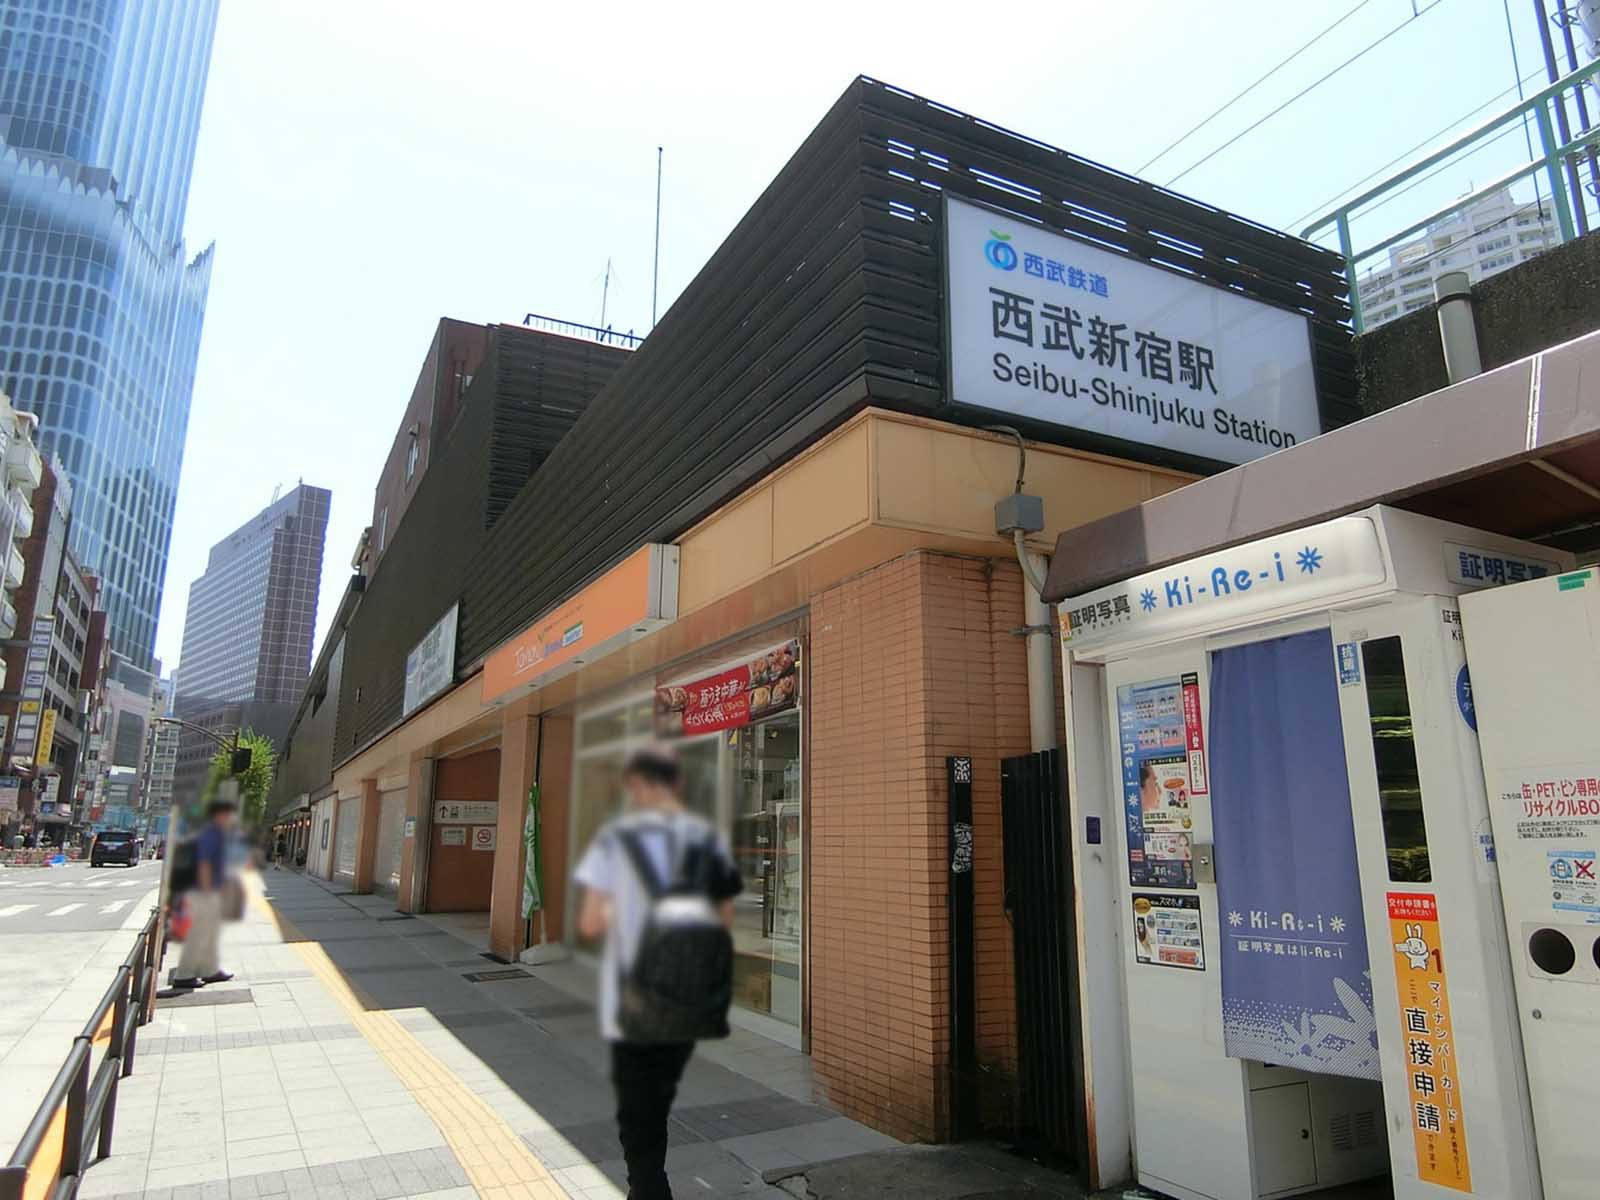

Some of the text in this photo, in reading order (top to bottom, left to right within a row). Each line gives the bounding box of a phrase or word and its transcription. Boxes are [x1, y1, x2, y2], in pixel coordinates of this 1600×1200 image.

[1023, 252, 1109, 298] 西武鉄道
[988, 286, 1219, 396] 西武新宿駅
[992, 352, 1297, 449] Seibu-Shinjuku Station
[1164, 551, 1285, 609] Ki-Re-i
[1523, 799, 1600, 818] リサイクルBO
[1405, 1007, 1441, 1133] 直接申請
[1429, 981, 1458, 1122] マイナンバーカード
